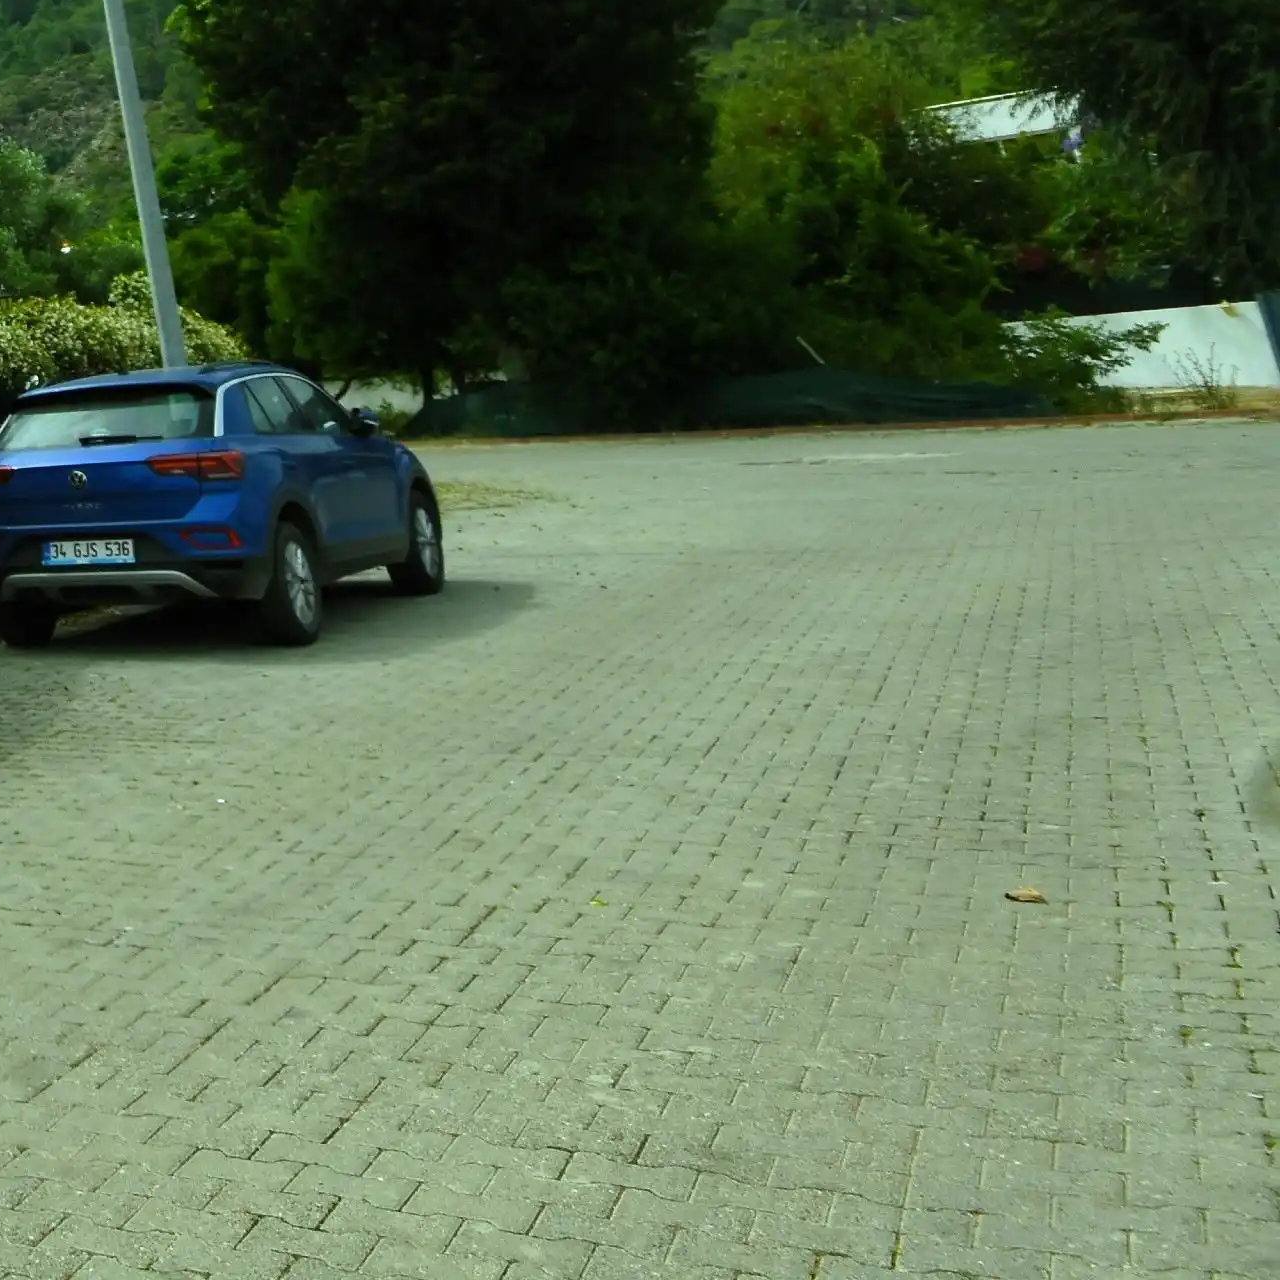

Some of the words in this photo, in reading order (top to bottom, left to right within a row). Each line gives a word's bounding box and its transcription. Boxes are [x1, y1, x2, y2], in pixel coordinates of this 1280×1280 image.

[51, 543, 66, 559] 34
[73, 542, 98, 558] GJS
[105, 541, 130, 557] 536
